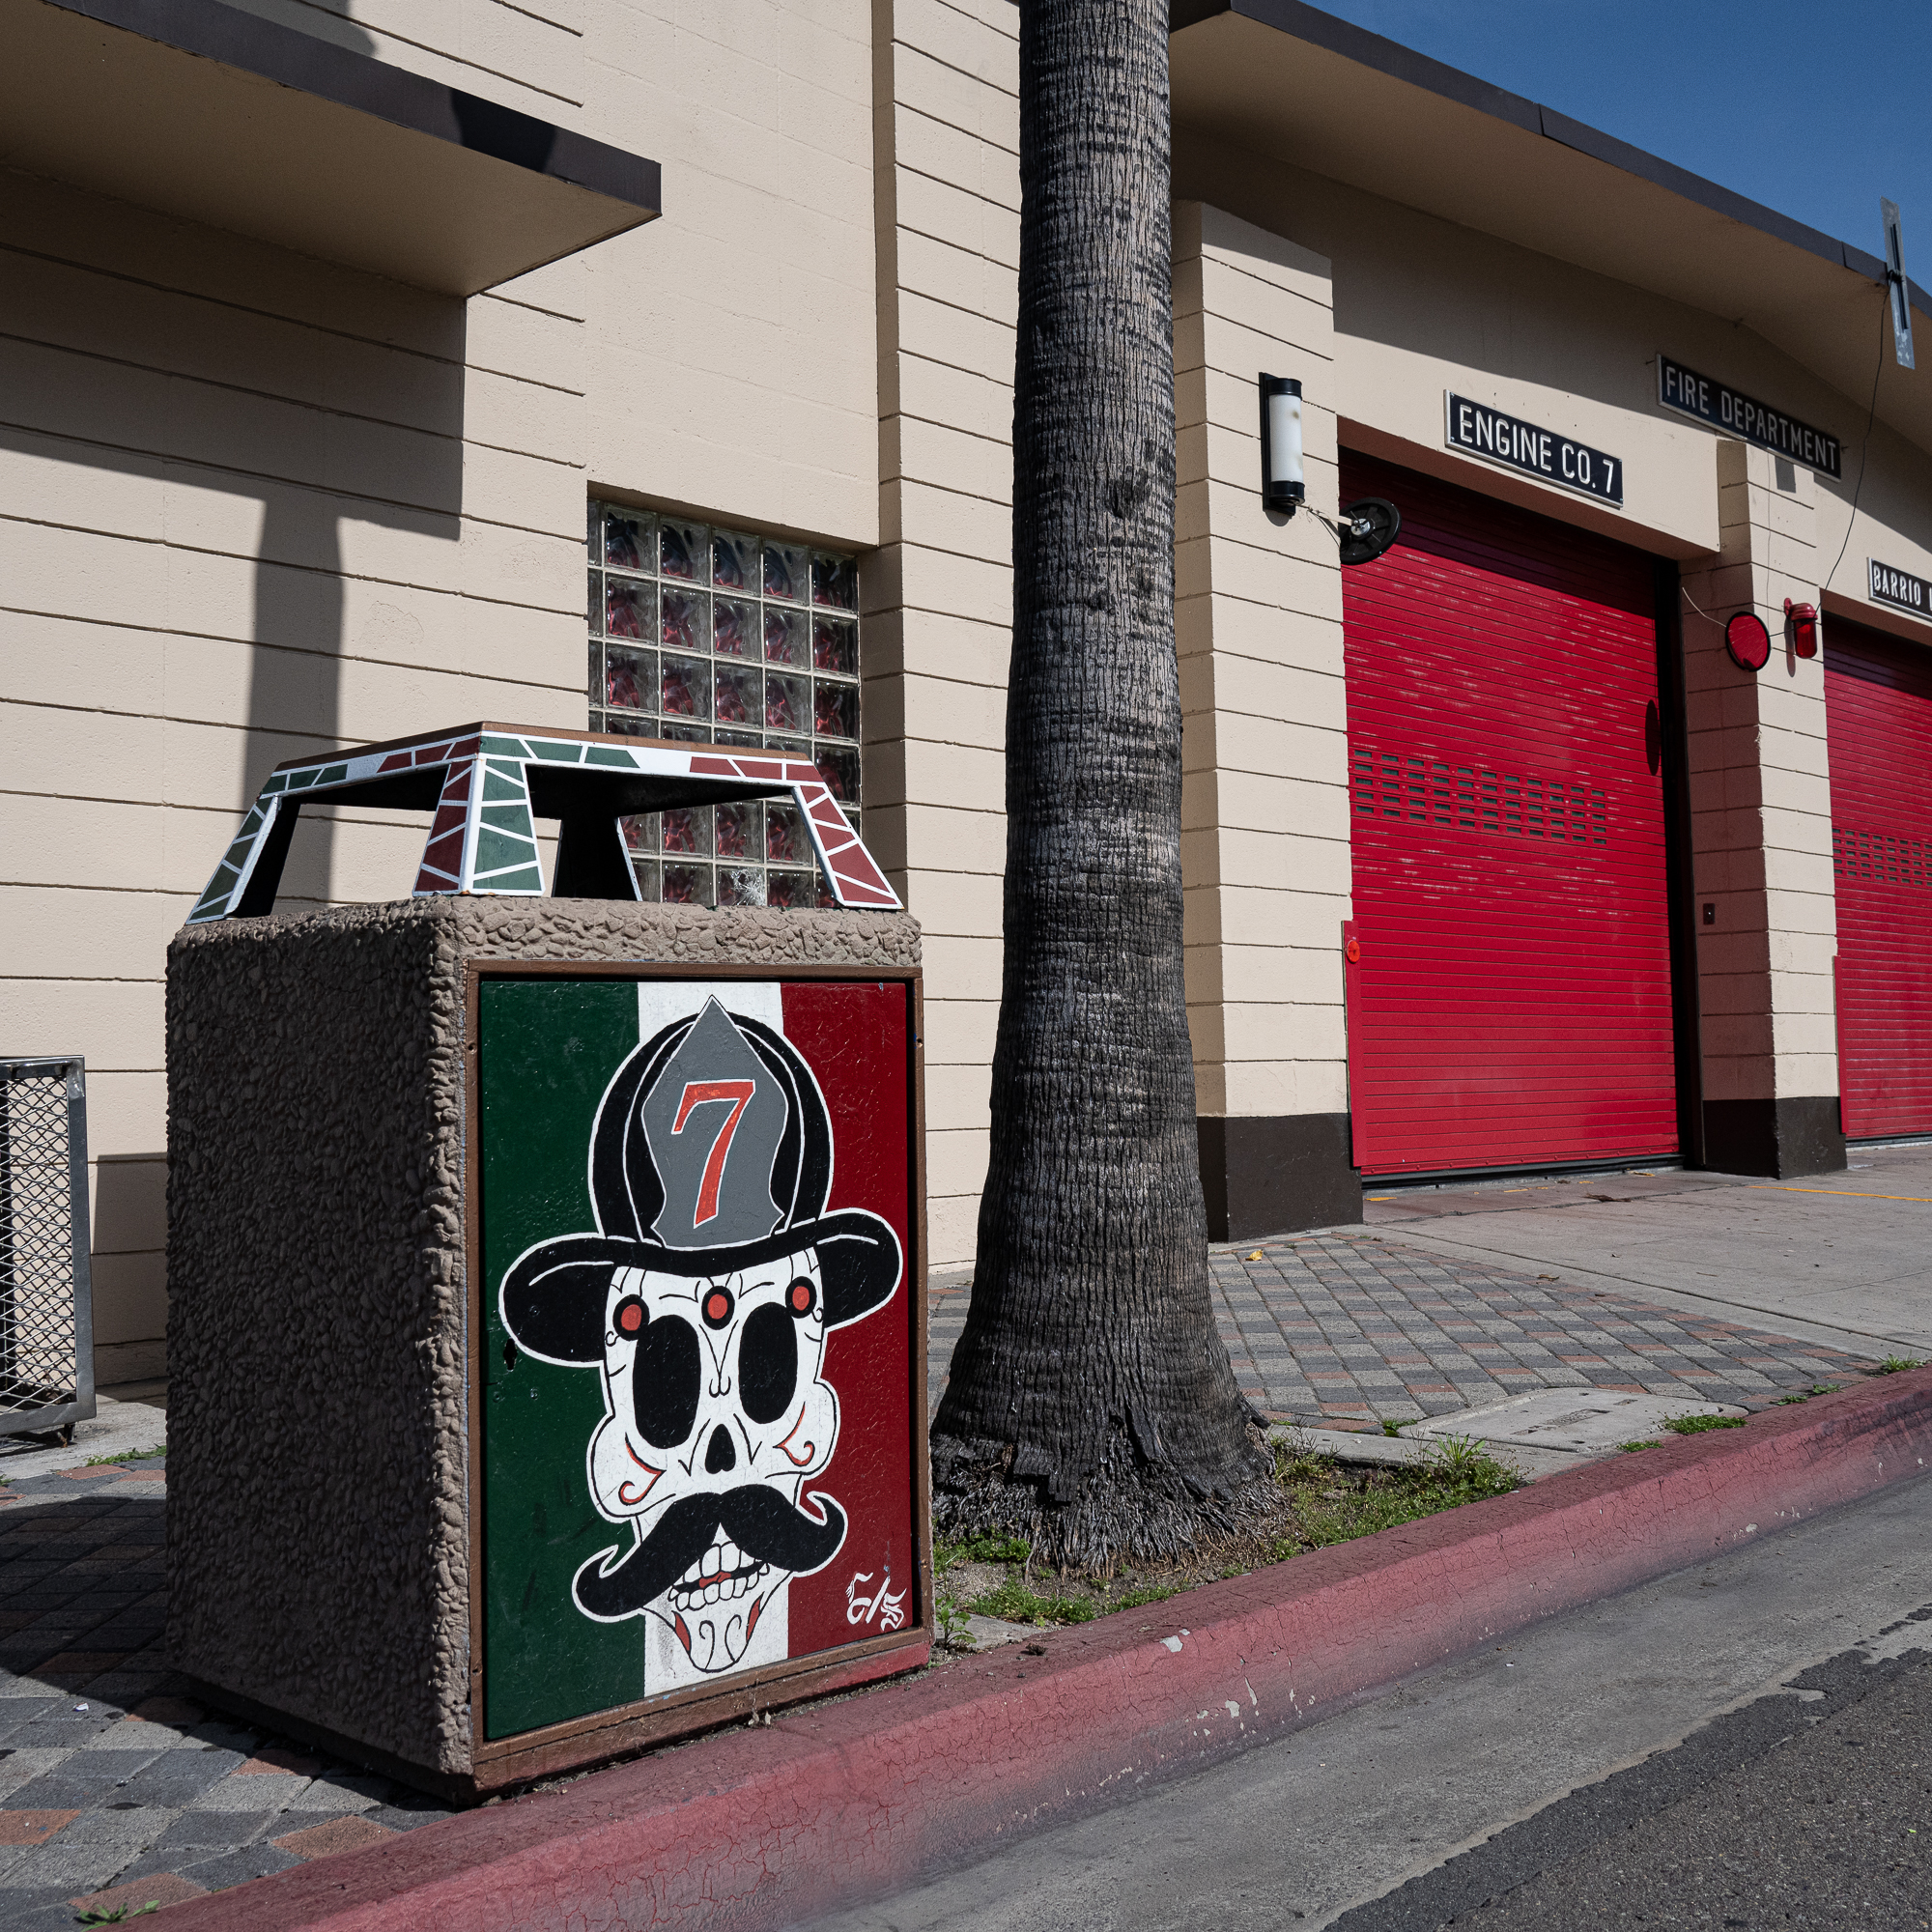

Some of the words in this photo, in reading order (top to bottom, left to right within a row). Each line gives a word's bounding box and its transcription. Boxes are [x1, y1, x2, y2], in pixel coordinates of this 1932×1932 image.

[1460, 404, 1551, 472] ENGINE
[1561, 442, 1596, 489] CO.
[1603, 458, 1613, 494] 7
[1666, 366, 1709, 415] FIRE
[1721, 390, 1836, 470] DEPARTMENT
[1873, 564, 1921, 607] BARRIO
[671, 1078, 755, 1229] 7
